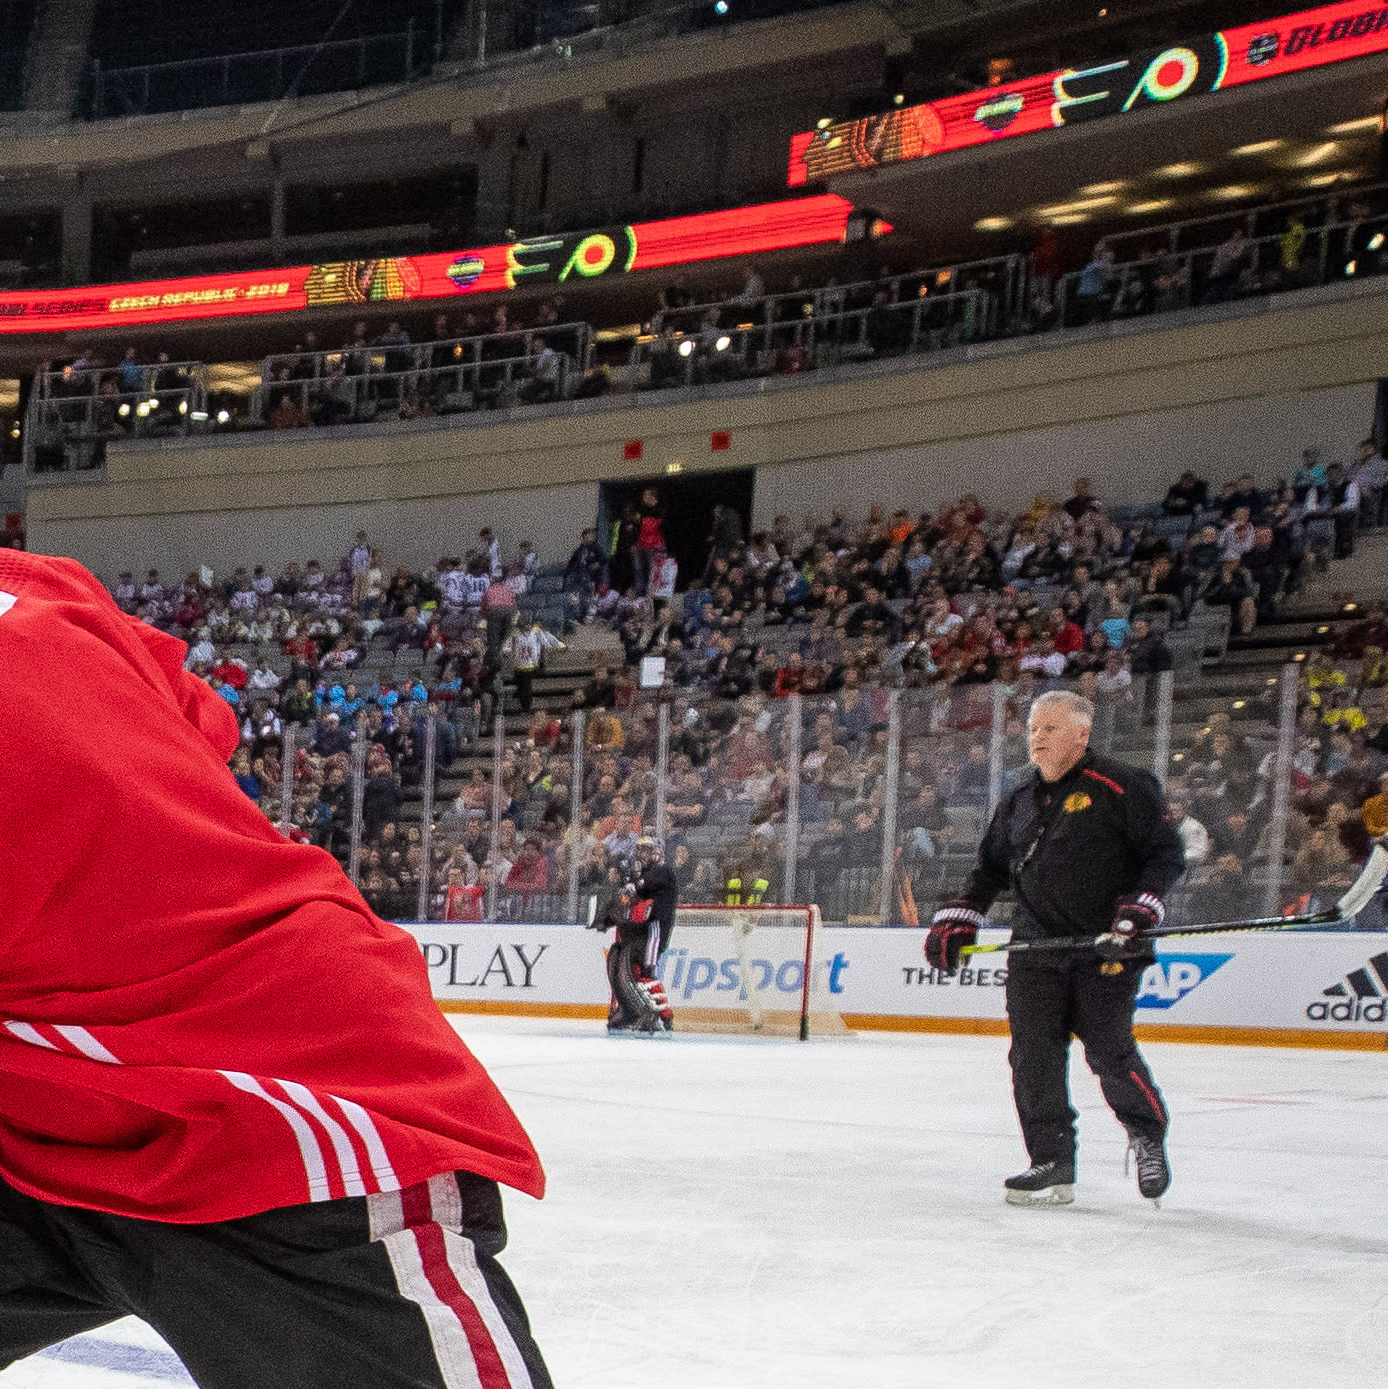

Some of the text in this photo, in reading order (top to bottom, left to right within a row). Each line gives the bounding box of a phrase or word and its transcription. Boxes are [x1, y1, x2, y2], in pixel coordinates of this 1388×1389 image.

[903, 967, 1008, 987] THE BES
[1306, 997, 1388, 1021] adid
